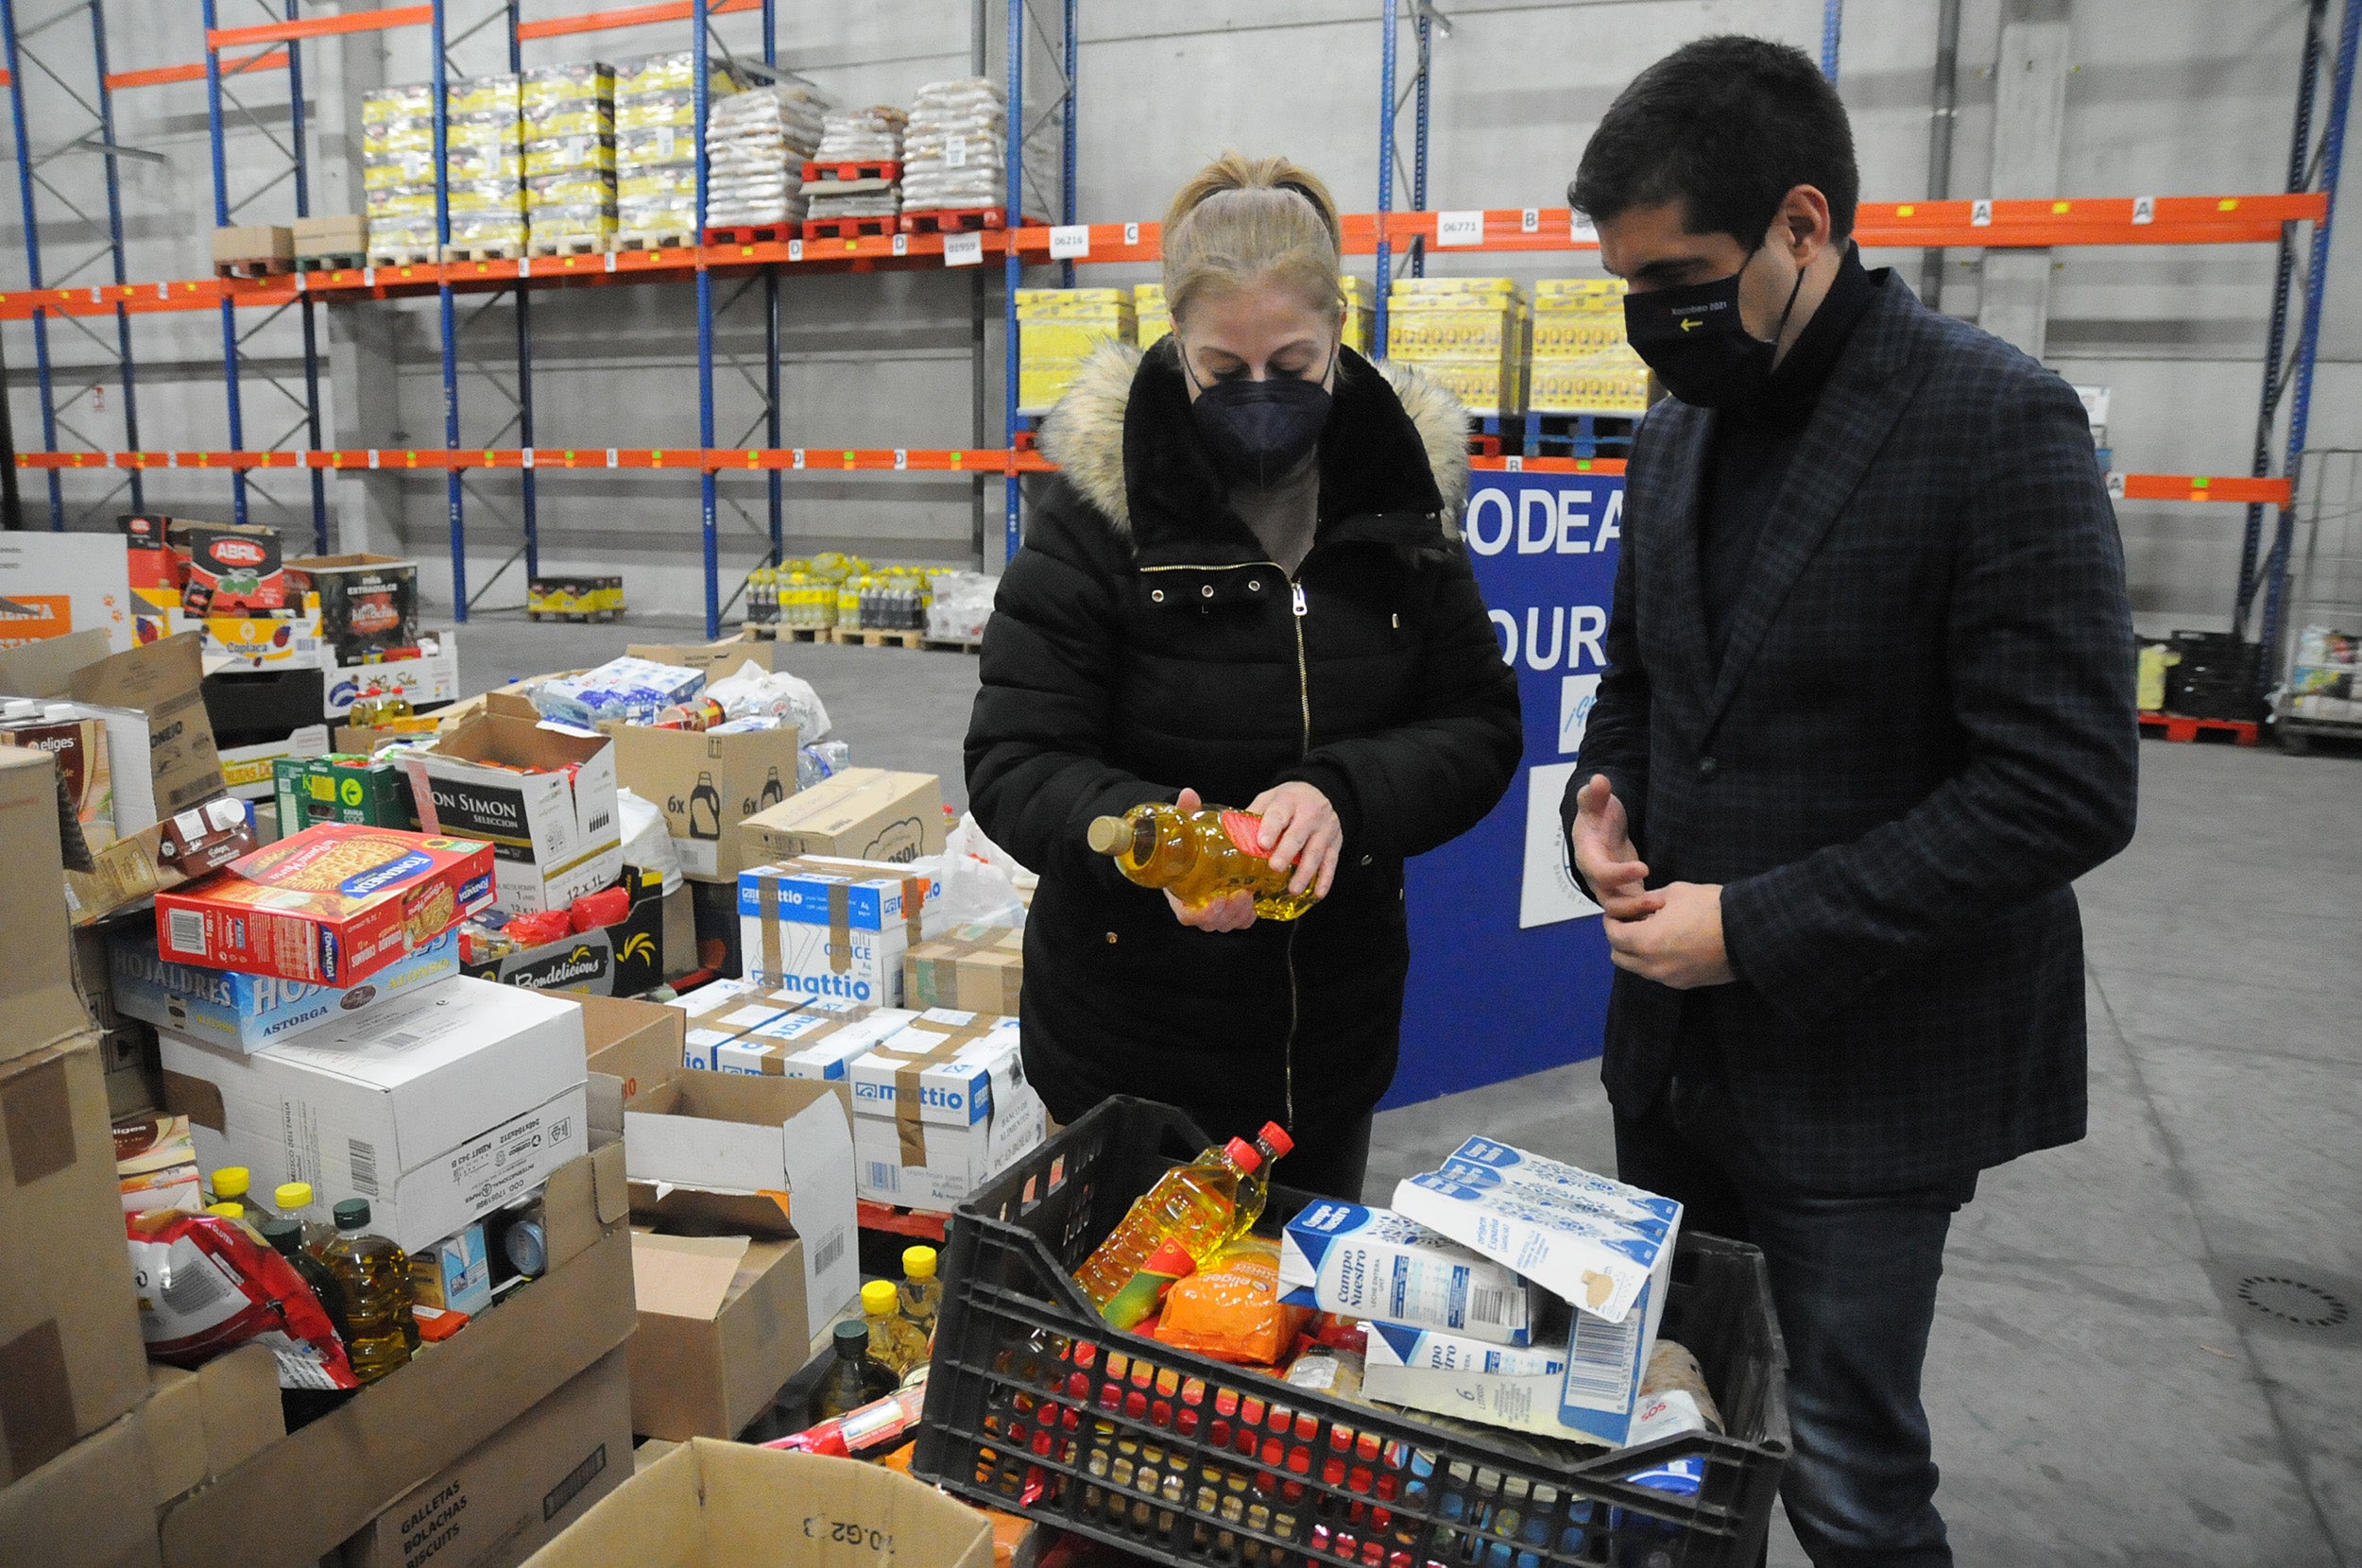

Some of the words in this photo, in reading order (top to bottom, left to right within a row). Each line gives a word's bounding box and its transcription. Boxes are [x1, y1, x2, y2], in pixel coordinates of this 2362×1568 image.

[1974, 203, 1989, 219] A
[2136, 201, 2151, 217] A
[1444, 222, 1477, 231] 06771
[1525, 213, 1536, 227] B
[1126, 226, 1136, 240] C
[1466, 487, 1624, 555] ODEA
[216, 543, 262, 562] ABRIL
[41, 737, 75, 752] eliges
[460, 793, 517, 818] SIMON
[668, 795, 685, 814] 6x
[743, 797, 757, 815] 6x
[473, 814, 518, 828] SELECCION
[345, 856, 432, 894] FONTANEDA
[567, 887, 580, 900] 12
[583, 883, 590, 893] x
[851, 930, 871, 947] ulti
[824, 943, 871, 961] OICE
[515, 958, 600, 989] Bondelicious
[783, 973, 870, 1001] mattio
[264, 1005, 329, 1037] ASTORGA
[1338, 1250, 1353, 1304] Campo
[1350, 1250, 1367, 1310] Nuestro
[1640, 1402, 1668, 1423] SOS
[401, 1479, 460, 1535] GALLETAS
[403, 1495, 468, 1556] BOLACHAS
[405, 1523, 460, 1568] BISCUITS
